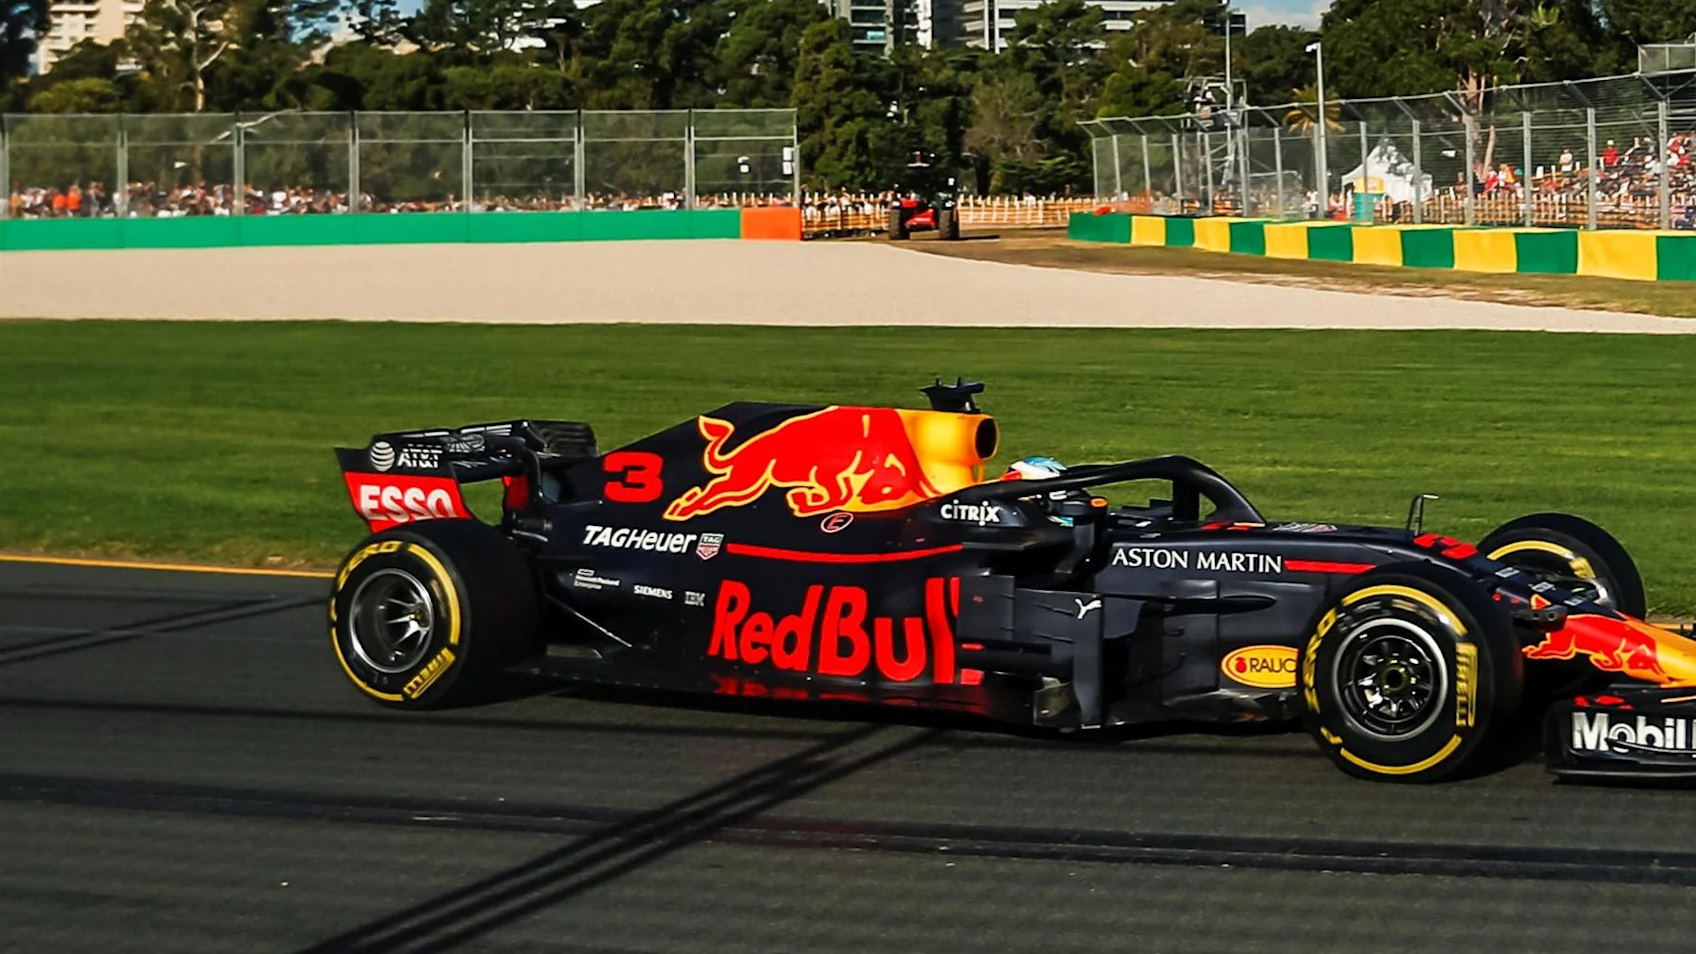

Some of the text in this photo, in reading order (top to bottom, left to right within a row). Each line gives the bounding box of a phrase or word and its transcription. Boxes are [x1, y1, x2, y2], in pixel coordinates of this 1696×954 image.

[604, 452, 663, 503] 3
[1112, 548, 1282, 573] ASTON MARTIN
[633, 584, 673, 599] SIEMENS
[1571, 712, 1687, 753] Mobil
